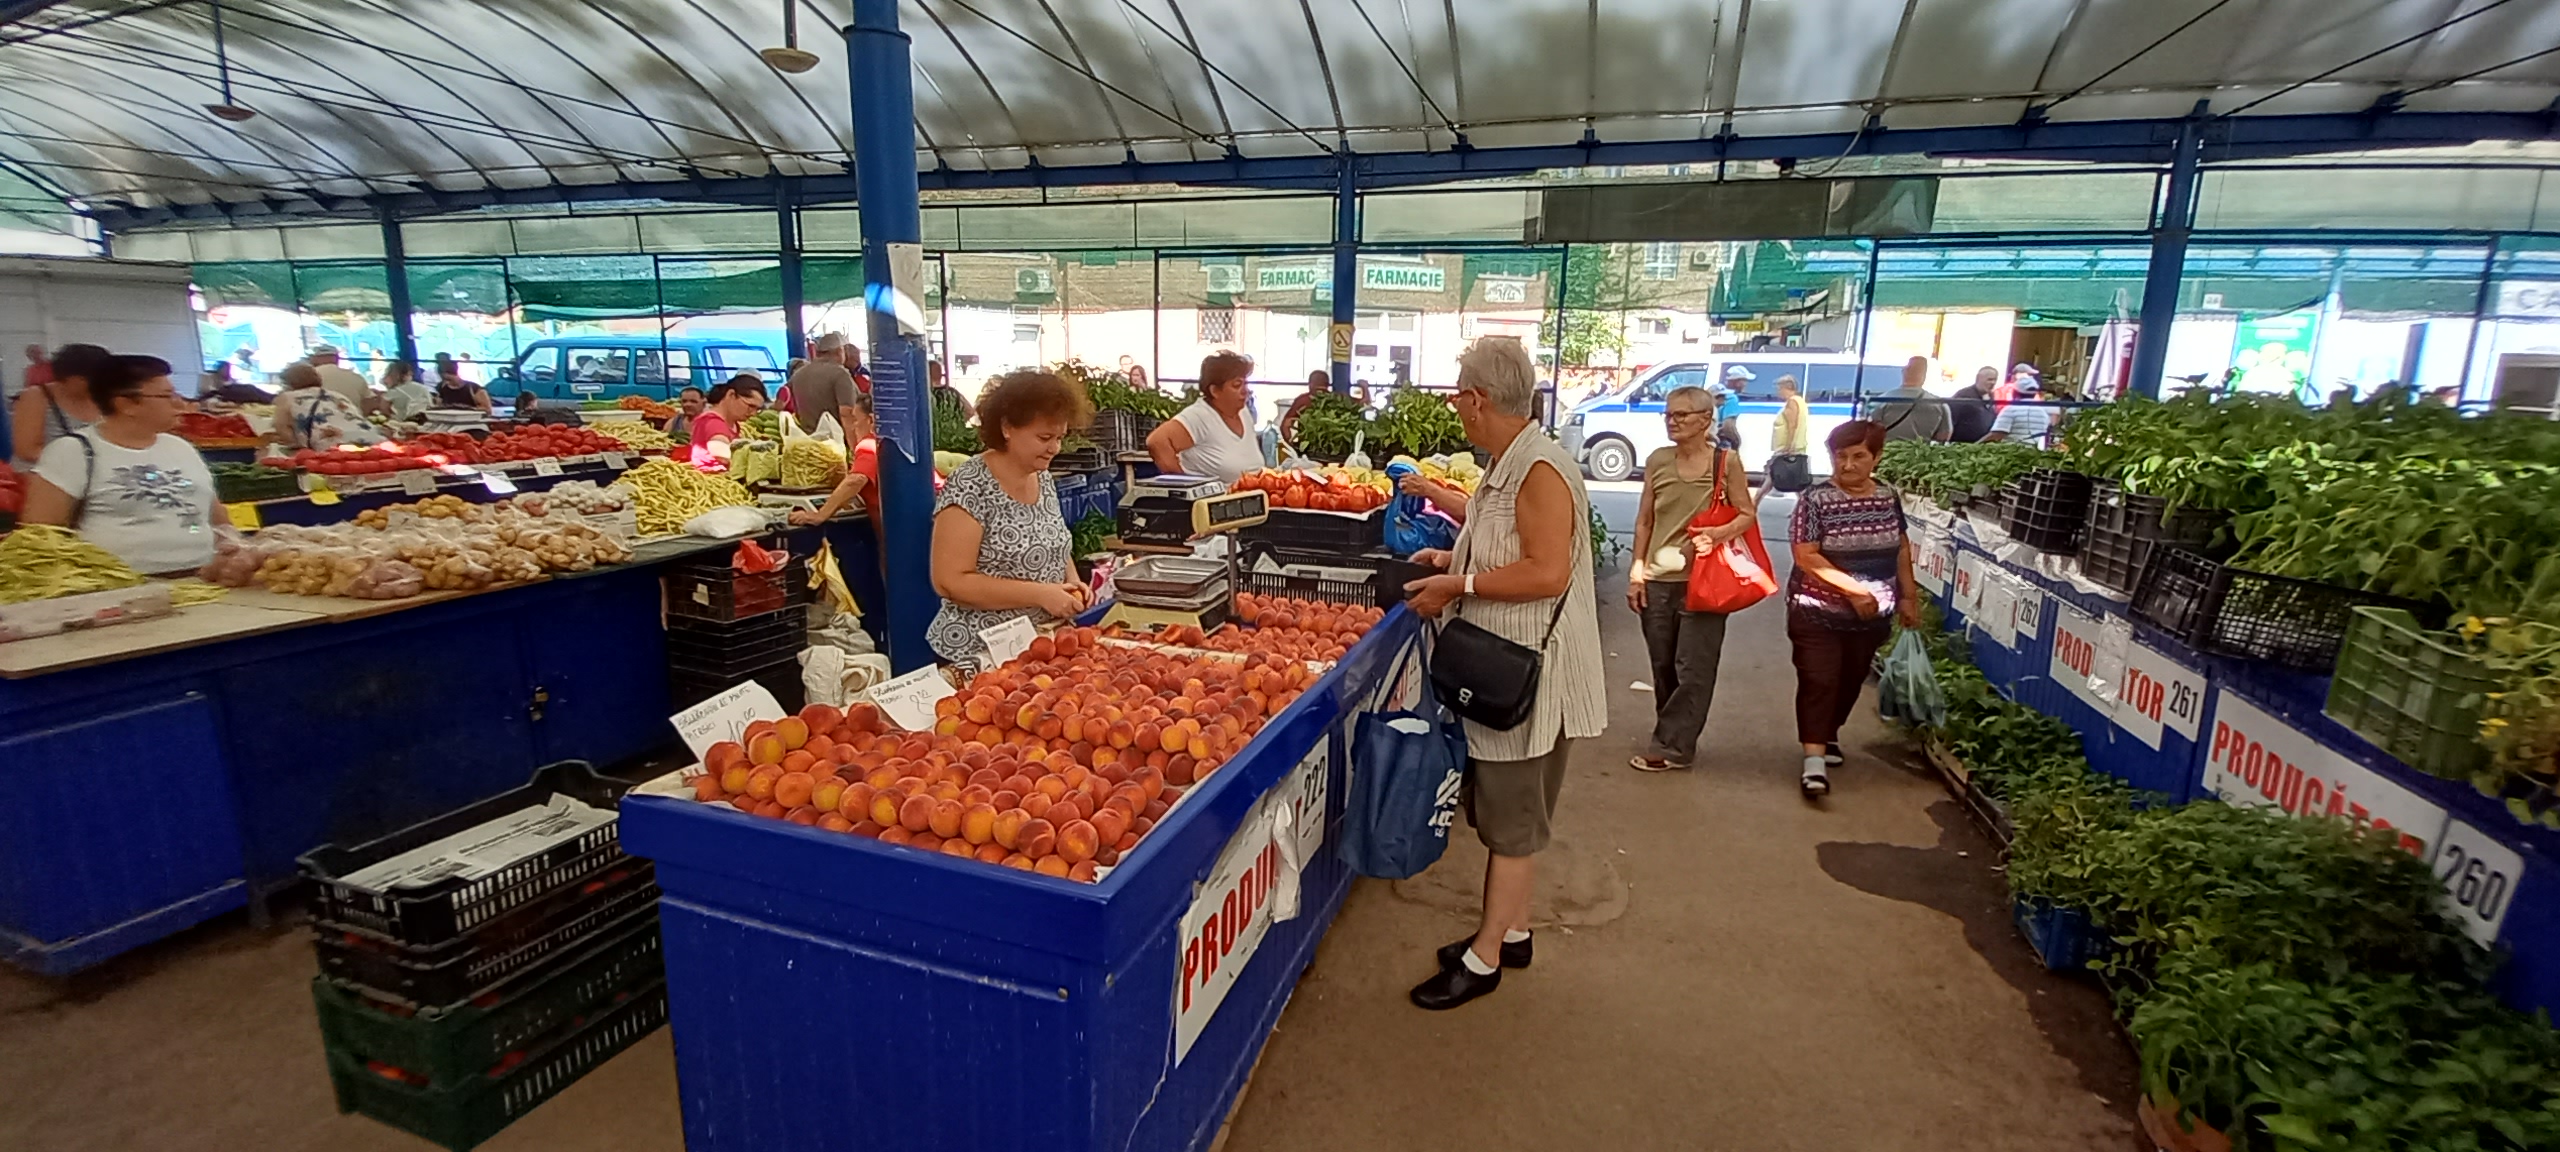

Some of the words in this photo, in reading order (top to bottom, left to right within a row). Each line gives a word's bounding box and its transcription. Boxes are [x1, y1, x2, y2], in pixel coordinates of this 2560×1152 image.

[1260, 269, 1316, 287] FARMAC
[1366, 268, 1442, 287] FARMACIE
[2020, 597, 2039, 628] 262
[2054, 626, 2165, 723] PRODTOR
[2168, 680, 2198, 724] 261
[1303, 755, 1326, 818] 222
[2211, 719, 2426, 857] PRODUCĂT
[2442, 843, 2508, 922] 260
